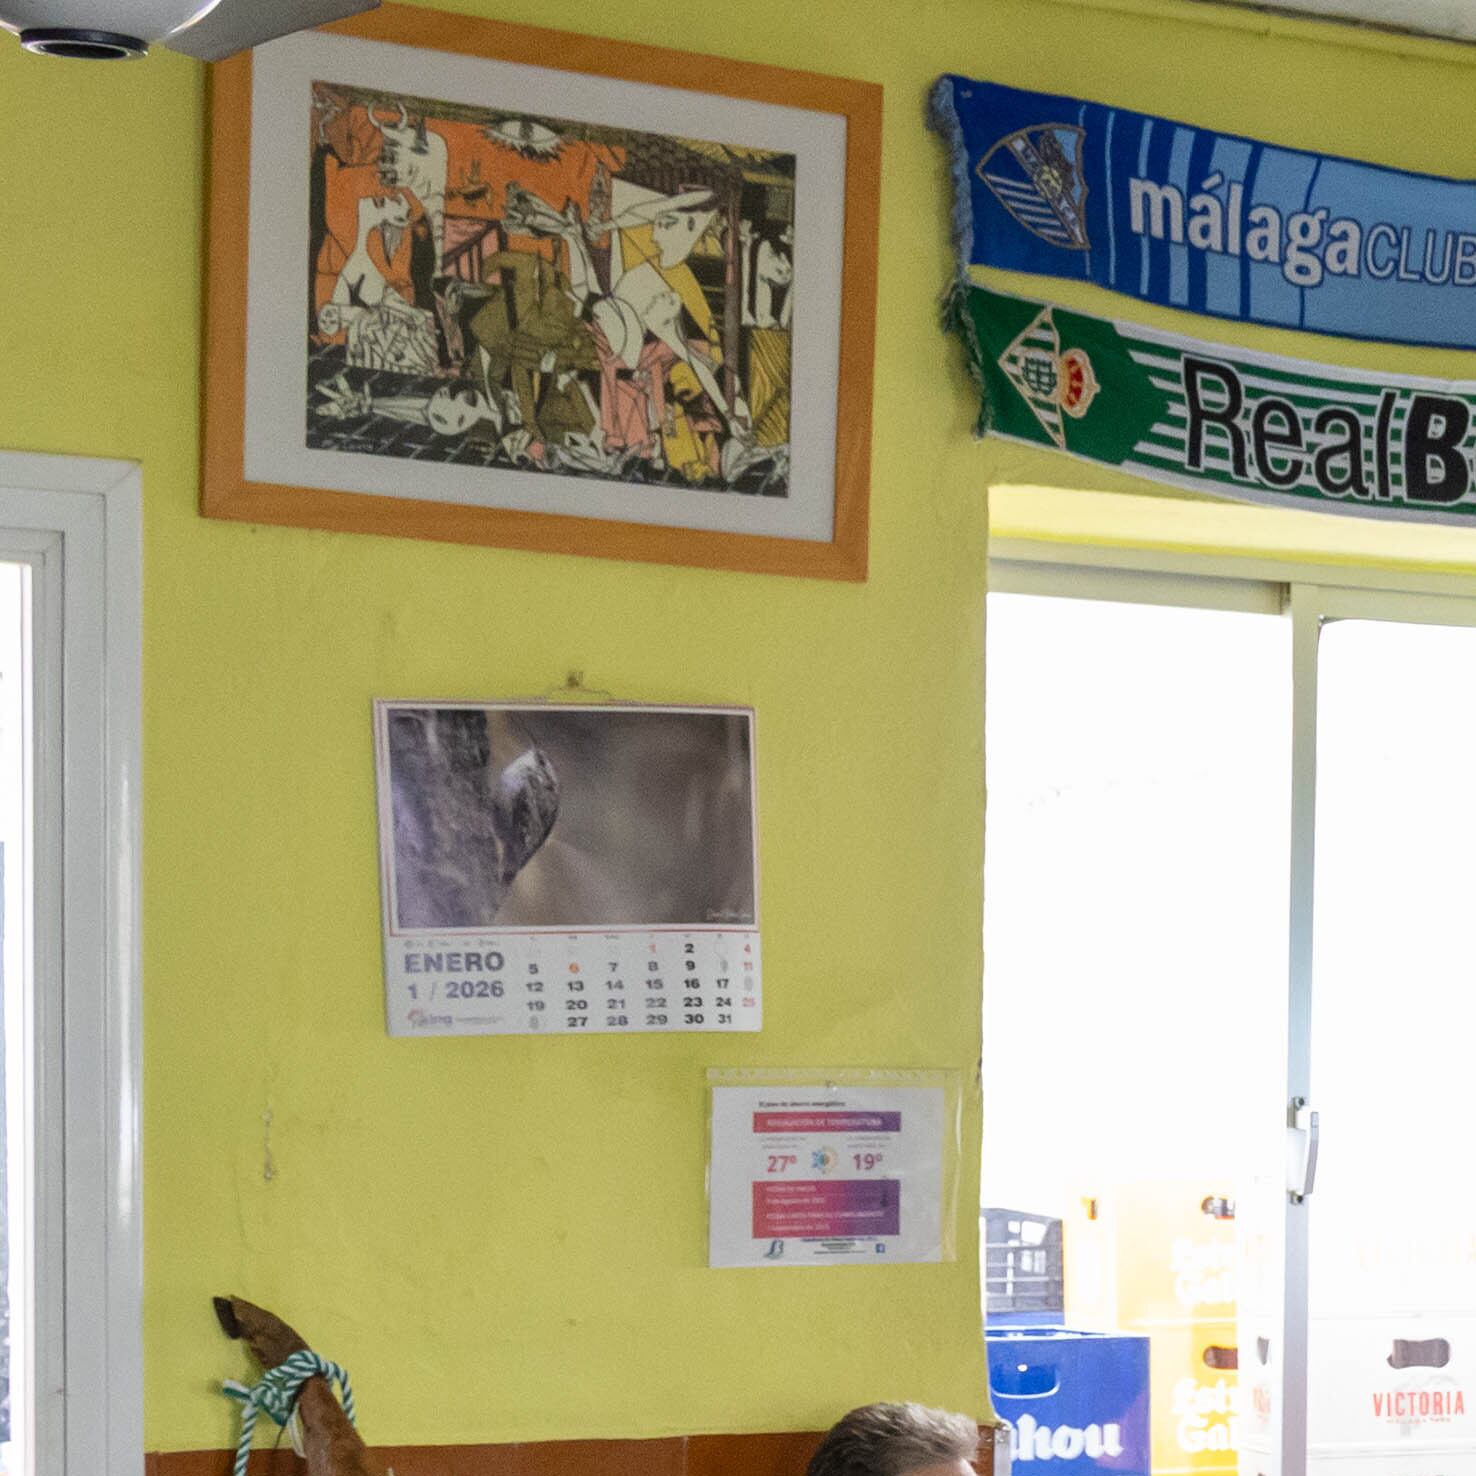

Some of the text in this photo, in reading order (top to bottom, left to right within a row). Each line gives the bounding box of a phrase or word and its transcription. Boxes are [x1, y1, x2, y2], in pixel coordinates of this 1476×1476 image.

[683, 943, 695, 953] 2
[403, 951, 505, 974] ENERO
[527, 963, 539, 974] 5
[608, 962, 619, 973] 7
[647, 961, 659, 972] 8
[685, 960, 696, 972] 9
[408, 982, 418, 999] 1
[445, 979, 505, 999] 2026
[526, 978, 730, 993] 12 13 14 15 16 17
[526, 1000, 545, 1012] 19
[565, 999, 588, 1011] 20
[606, 998, 626, 1010] 21
[645, 997, 667, 1009] 22
[683, 997, 703, 1008] 23
[715, 996, 732, 1008] 24
[567, 1013, 733, 1028] 27 28 29 30 31
[1372, 1390, 1465, 1418] VICTORIA
